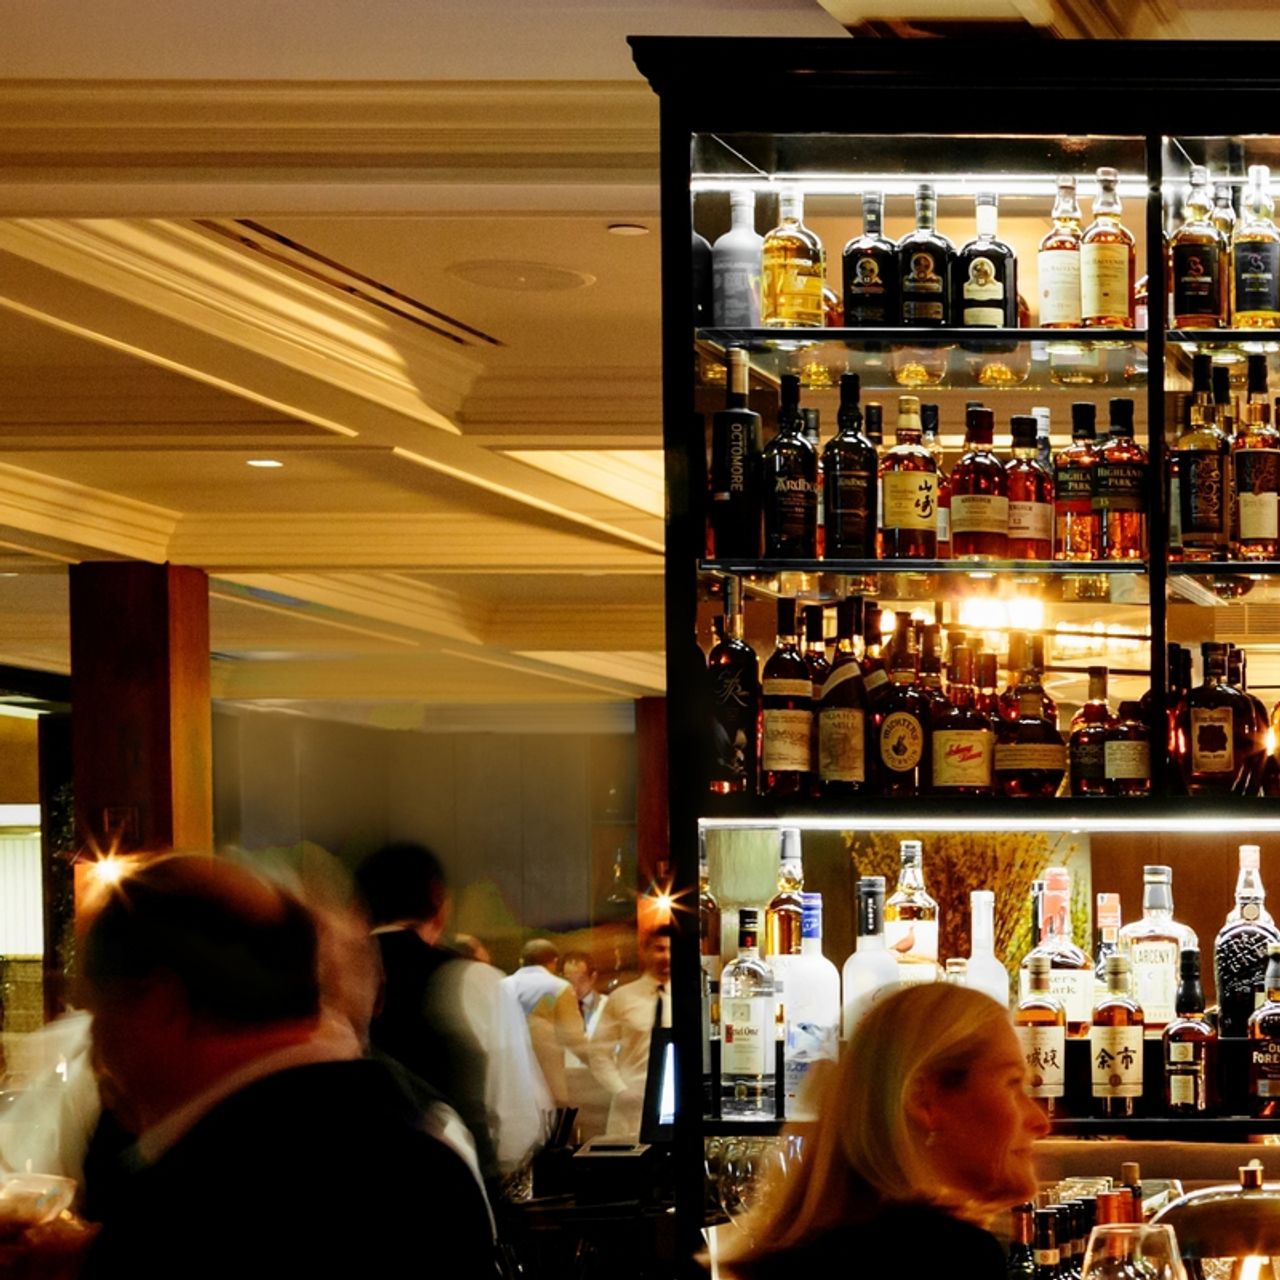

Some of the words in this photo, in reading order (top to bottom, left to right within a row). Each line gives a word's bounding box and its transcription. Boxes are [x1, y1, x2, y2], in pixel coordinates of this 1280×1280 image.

[730, 423, 744, 492] OCTOMORE
[1058, 471, 1092, 483] HIGHLA
[1097, 467, 1144, 479] HIGHLAND
[1107, 478, 1132, 488] PARK
[1095, 1046, 1136, 1070] 余市
